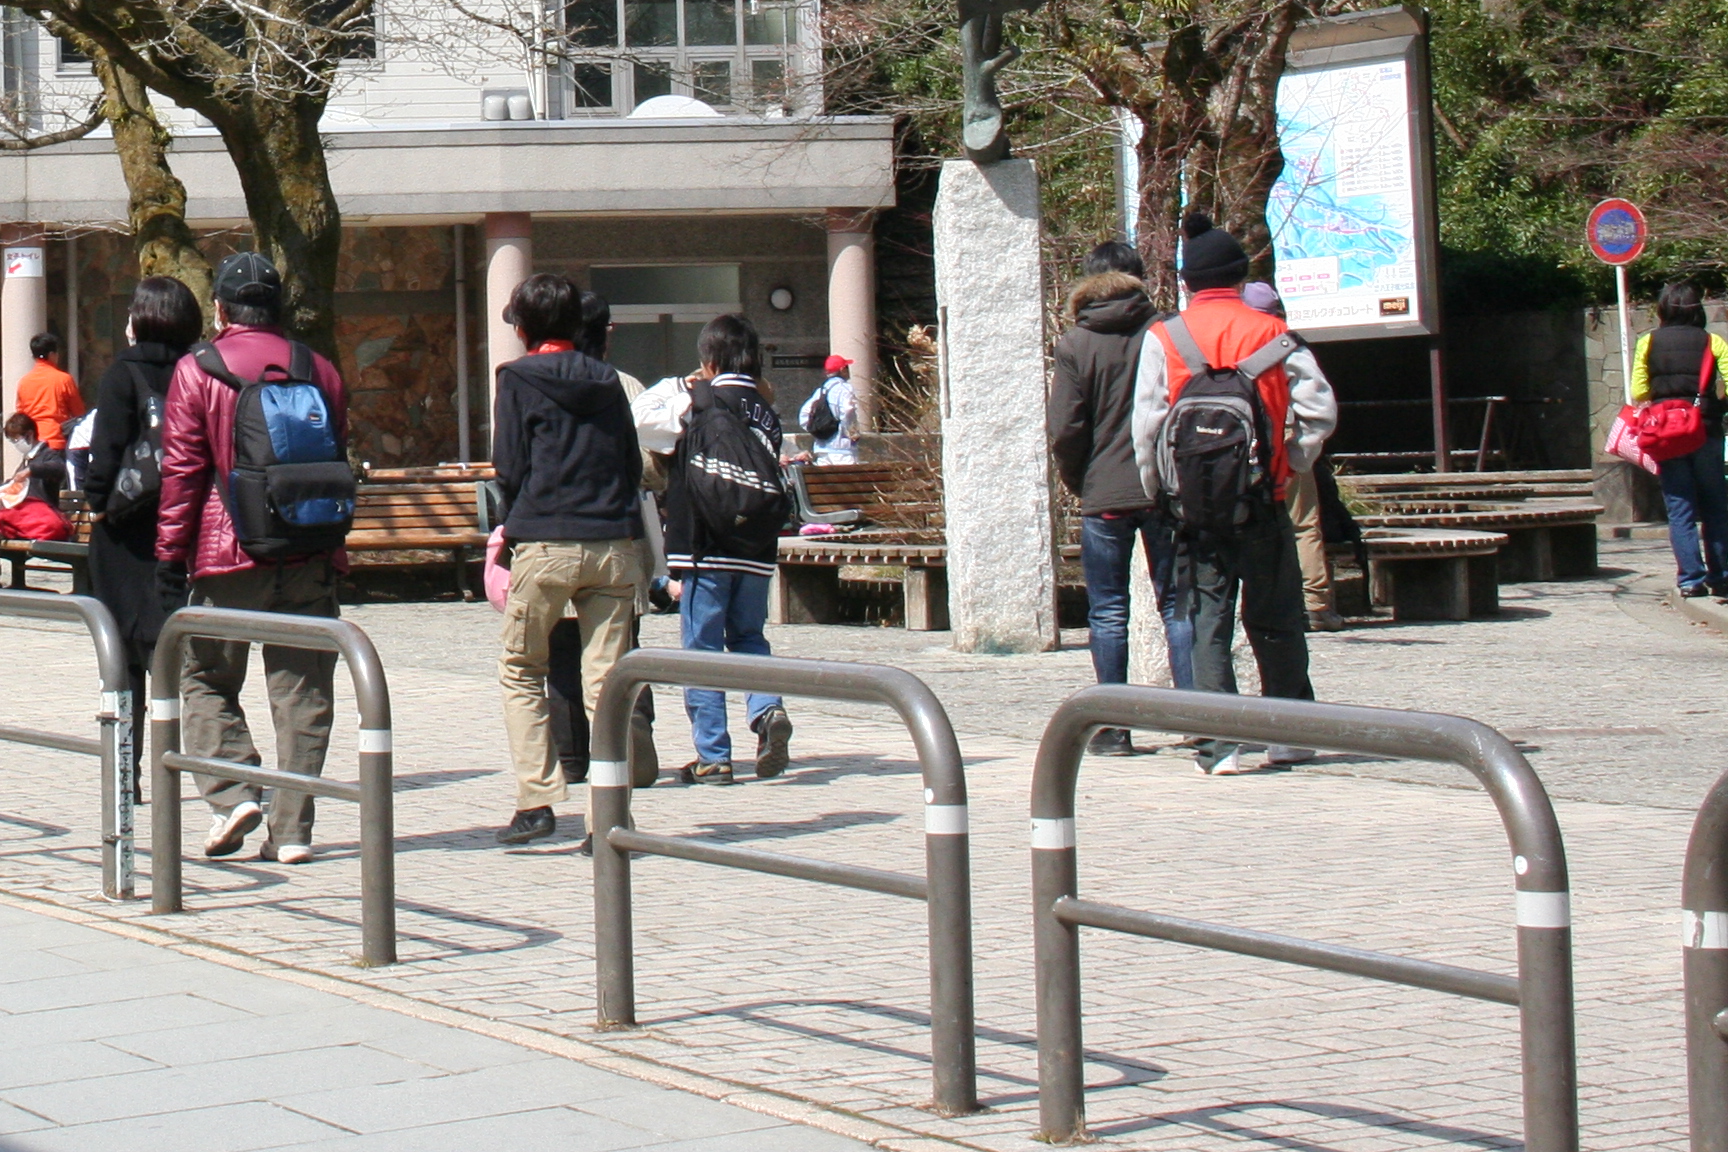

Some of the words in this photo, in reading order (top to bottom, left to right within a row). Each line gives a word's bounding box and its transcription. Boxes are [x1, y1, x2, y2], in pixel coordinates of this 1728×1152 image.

[6, 251, 41, 261] 女子トイレ
